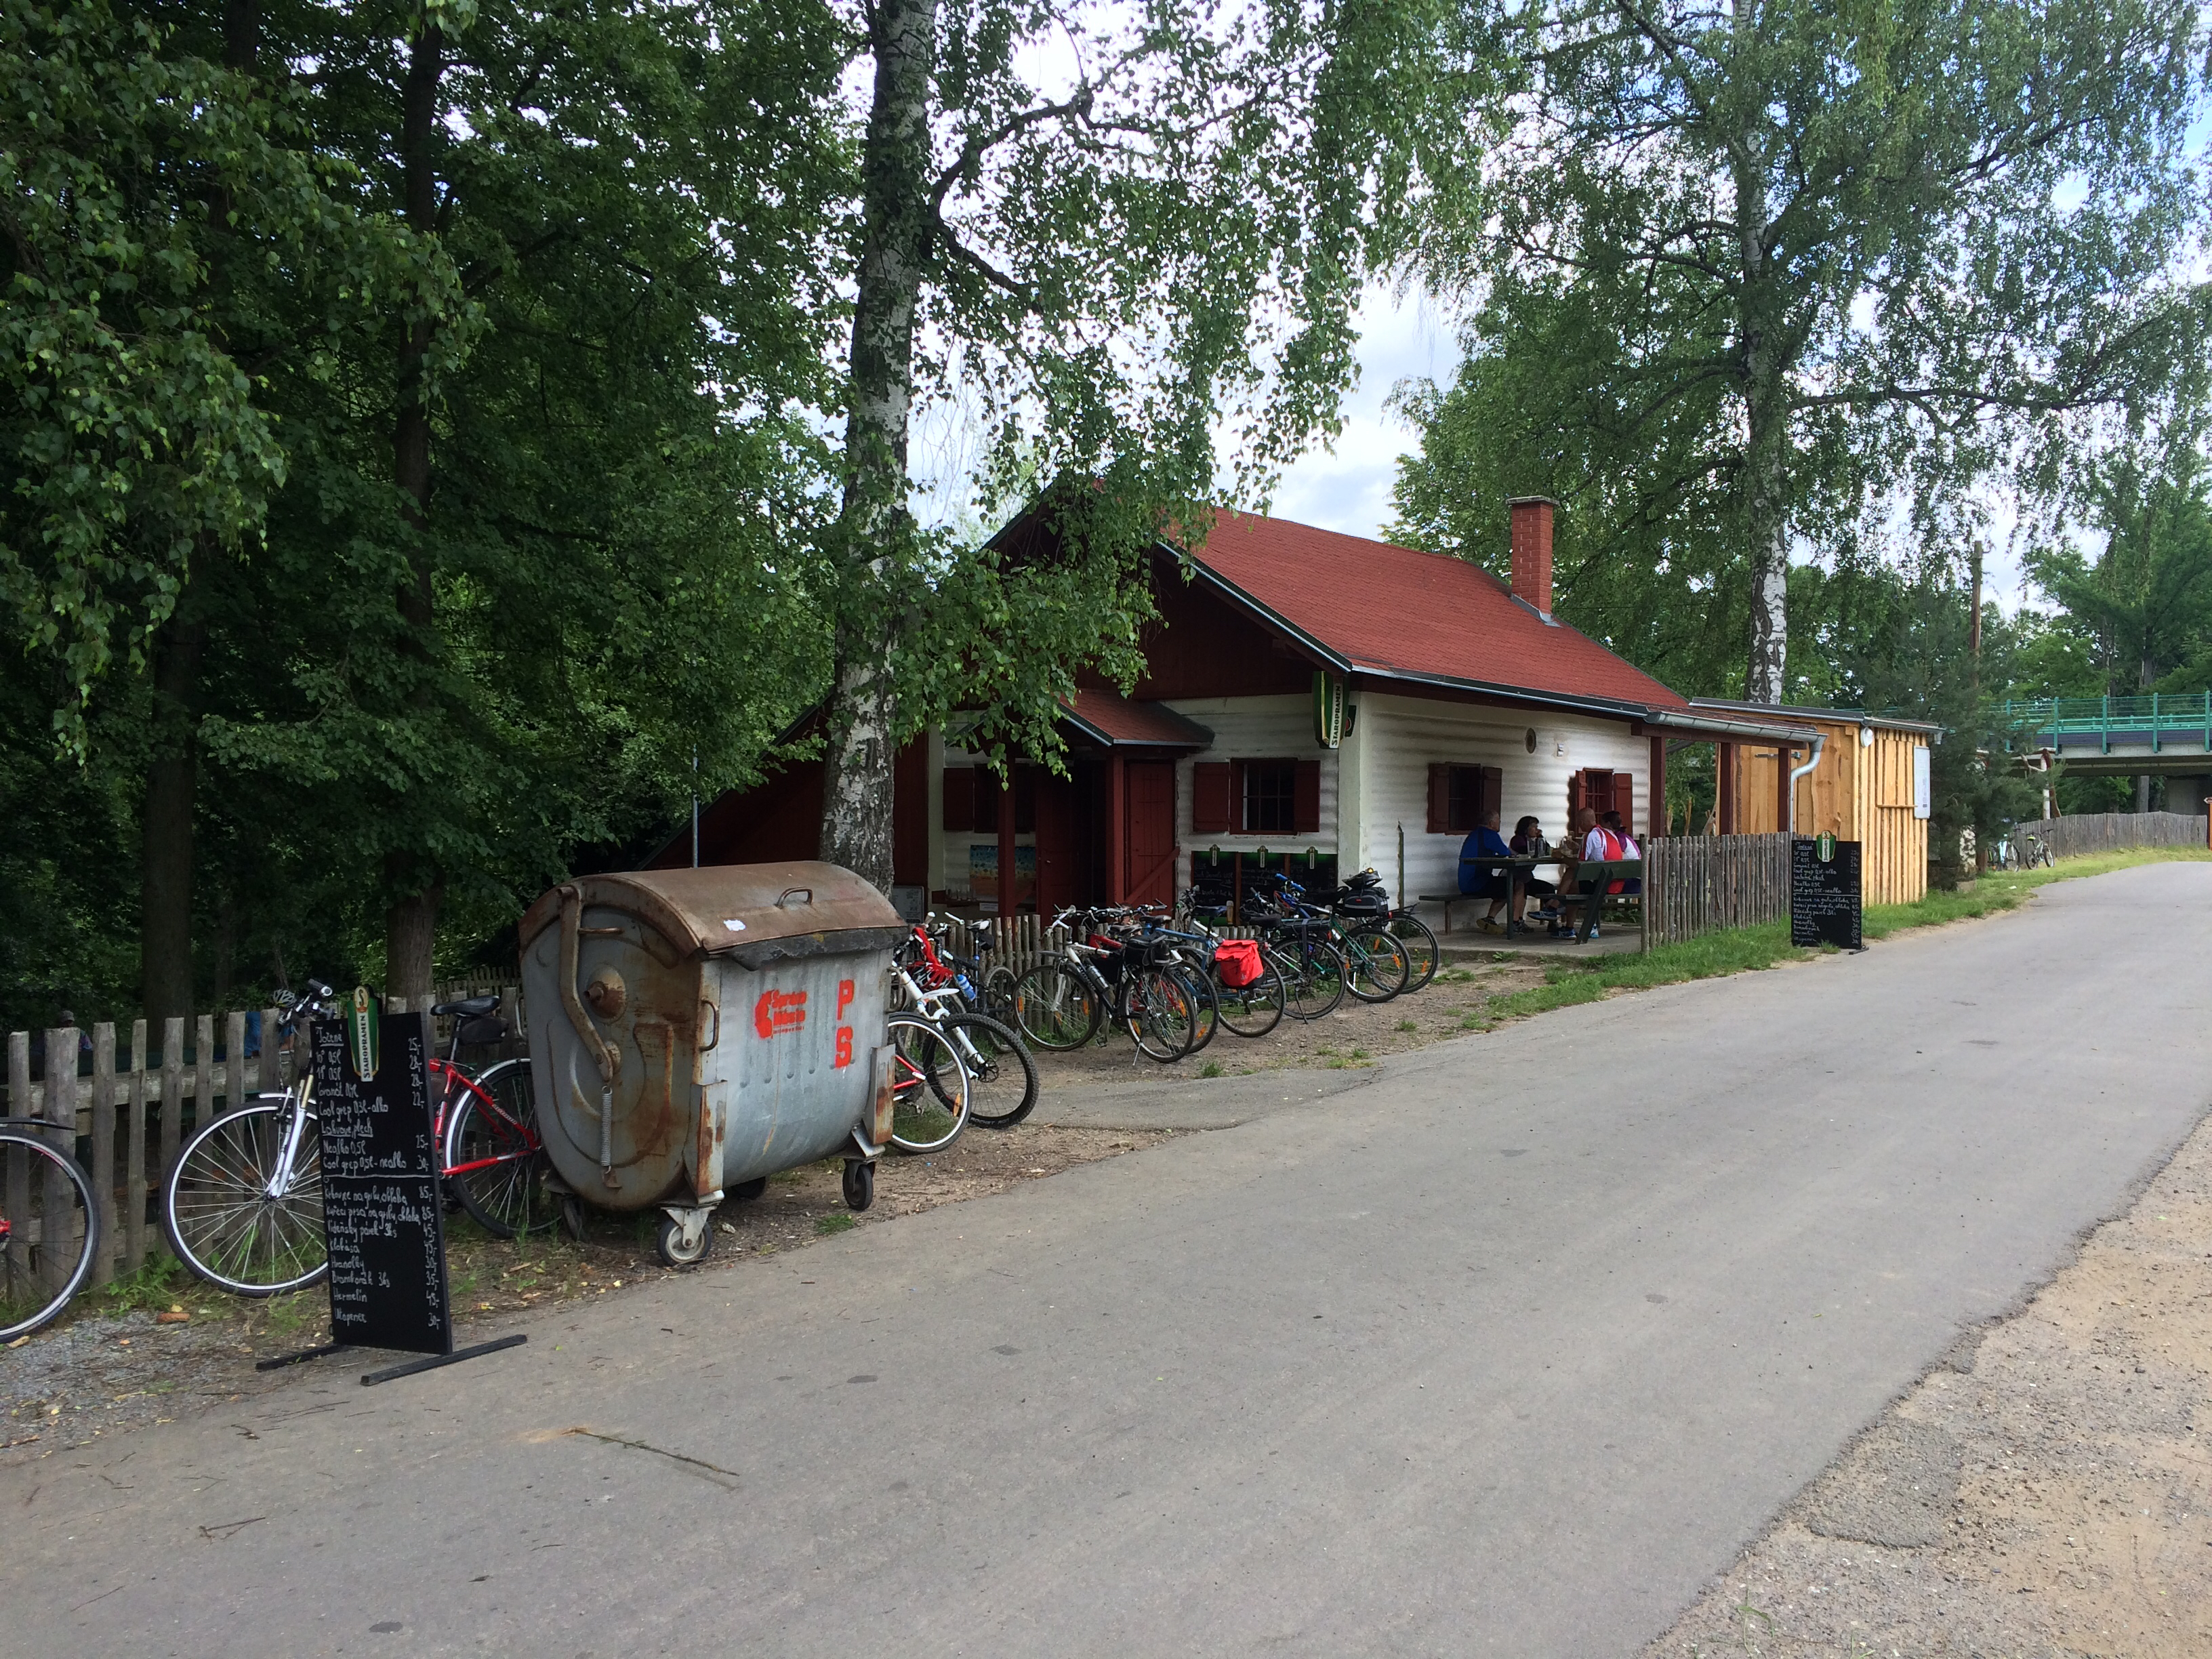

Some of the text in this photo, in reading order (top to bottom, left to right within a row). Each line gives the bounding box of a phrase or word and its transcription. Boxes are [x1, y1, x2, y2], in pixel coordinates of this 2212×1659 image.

[1332, 686, 1341, 746] STAROPRAMEN
[360, 1015, 371, 1079] STAROPRAMEN
[323, 1139, 350, 1155] Nealko
